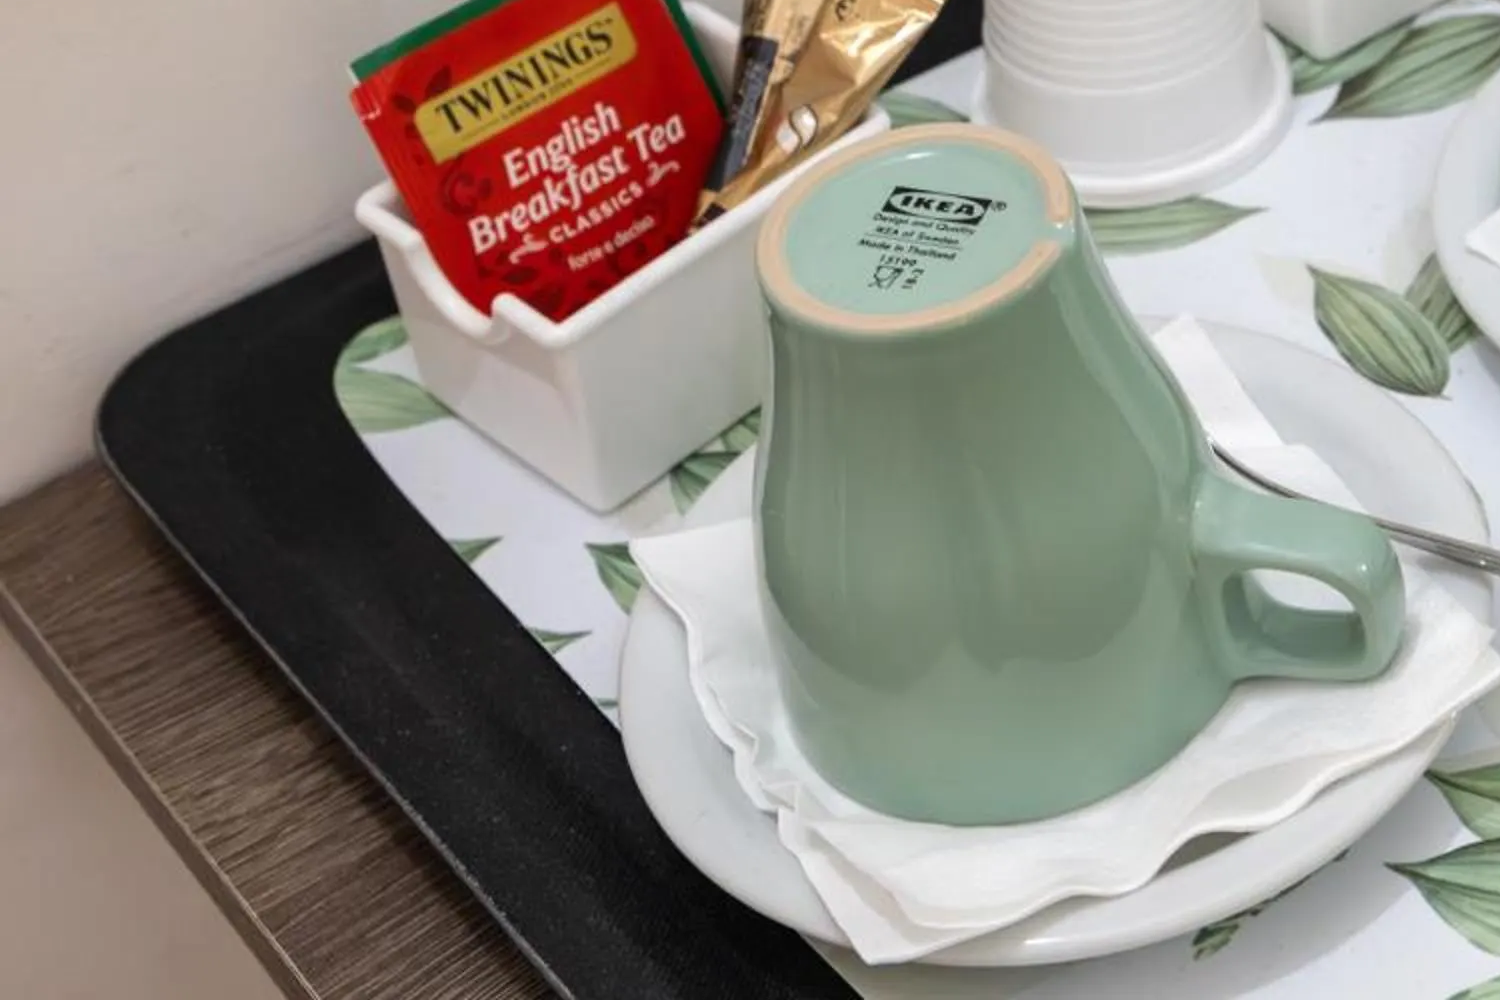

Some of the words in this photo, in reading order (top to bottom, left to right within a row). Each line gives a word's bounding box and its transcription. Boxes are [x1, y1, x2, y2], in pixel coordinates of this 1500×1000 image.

[434, 21, 613, 133] TWININGS
[503, 102, 622, 189] English
[467, 145, 629, 254] Breakfast
[626, 114, 686, 162] Tea
[548, 184, 643, 244] CLASSICS
[873, 212, 909, 225] Design
[911, 220, 934, 228] and
[901, 195, 976, 216] IKEA
[858, 239, 891, 250] Made
[906, 245, 957, 260] Thailand
[876, 226, 899, 235] IKEA
[917, 231, 959, 244] Sweden
